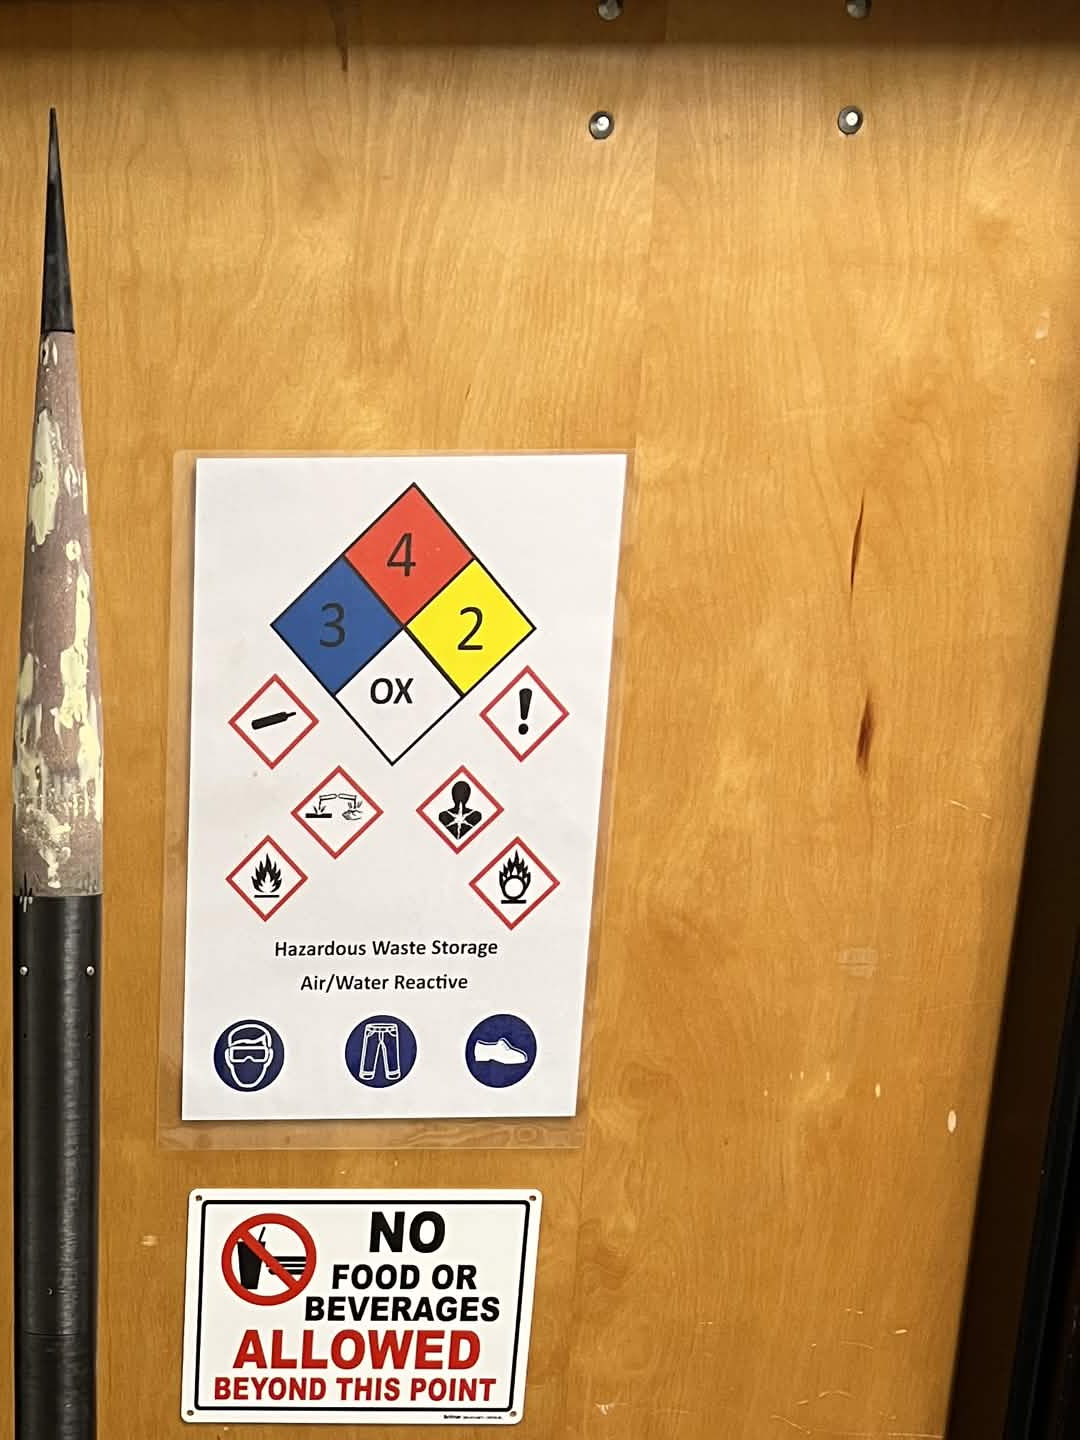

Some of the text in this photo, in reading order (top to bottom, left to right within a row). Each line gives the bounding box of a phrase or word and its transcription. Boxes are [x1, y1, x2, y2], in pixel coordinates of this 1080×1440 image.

[387, 533, 416, 577] 4
[319, 603, 483, 651] 3 2
[369, 677, 414, 704] OX
[274, 939, 498, 959] Hazardous Waste Storage
[300, 973, 468, 993] Air/Water Reactive
[369, 1211, 446, 1253] NO
[331, 1264, 477, 1290] FOOD OR
[304, 1296, 500, 1322] BEVERAGES
[232, 1329, 481, 1370] ALLOWED
[214, 1377, 497, 1401] BEYOND THIS POINT
